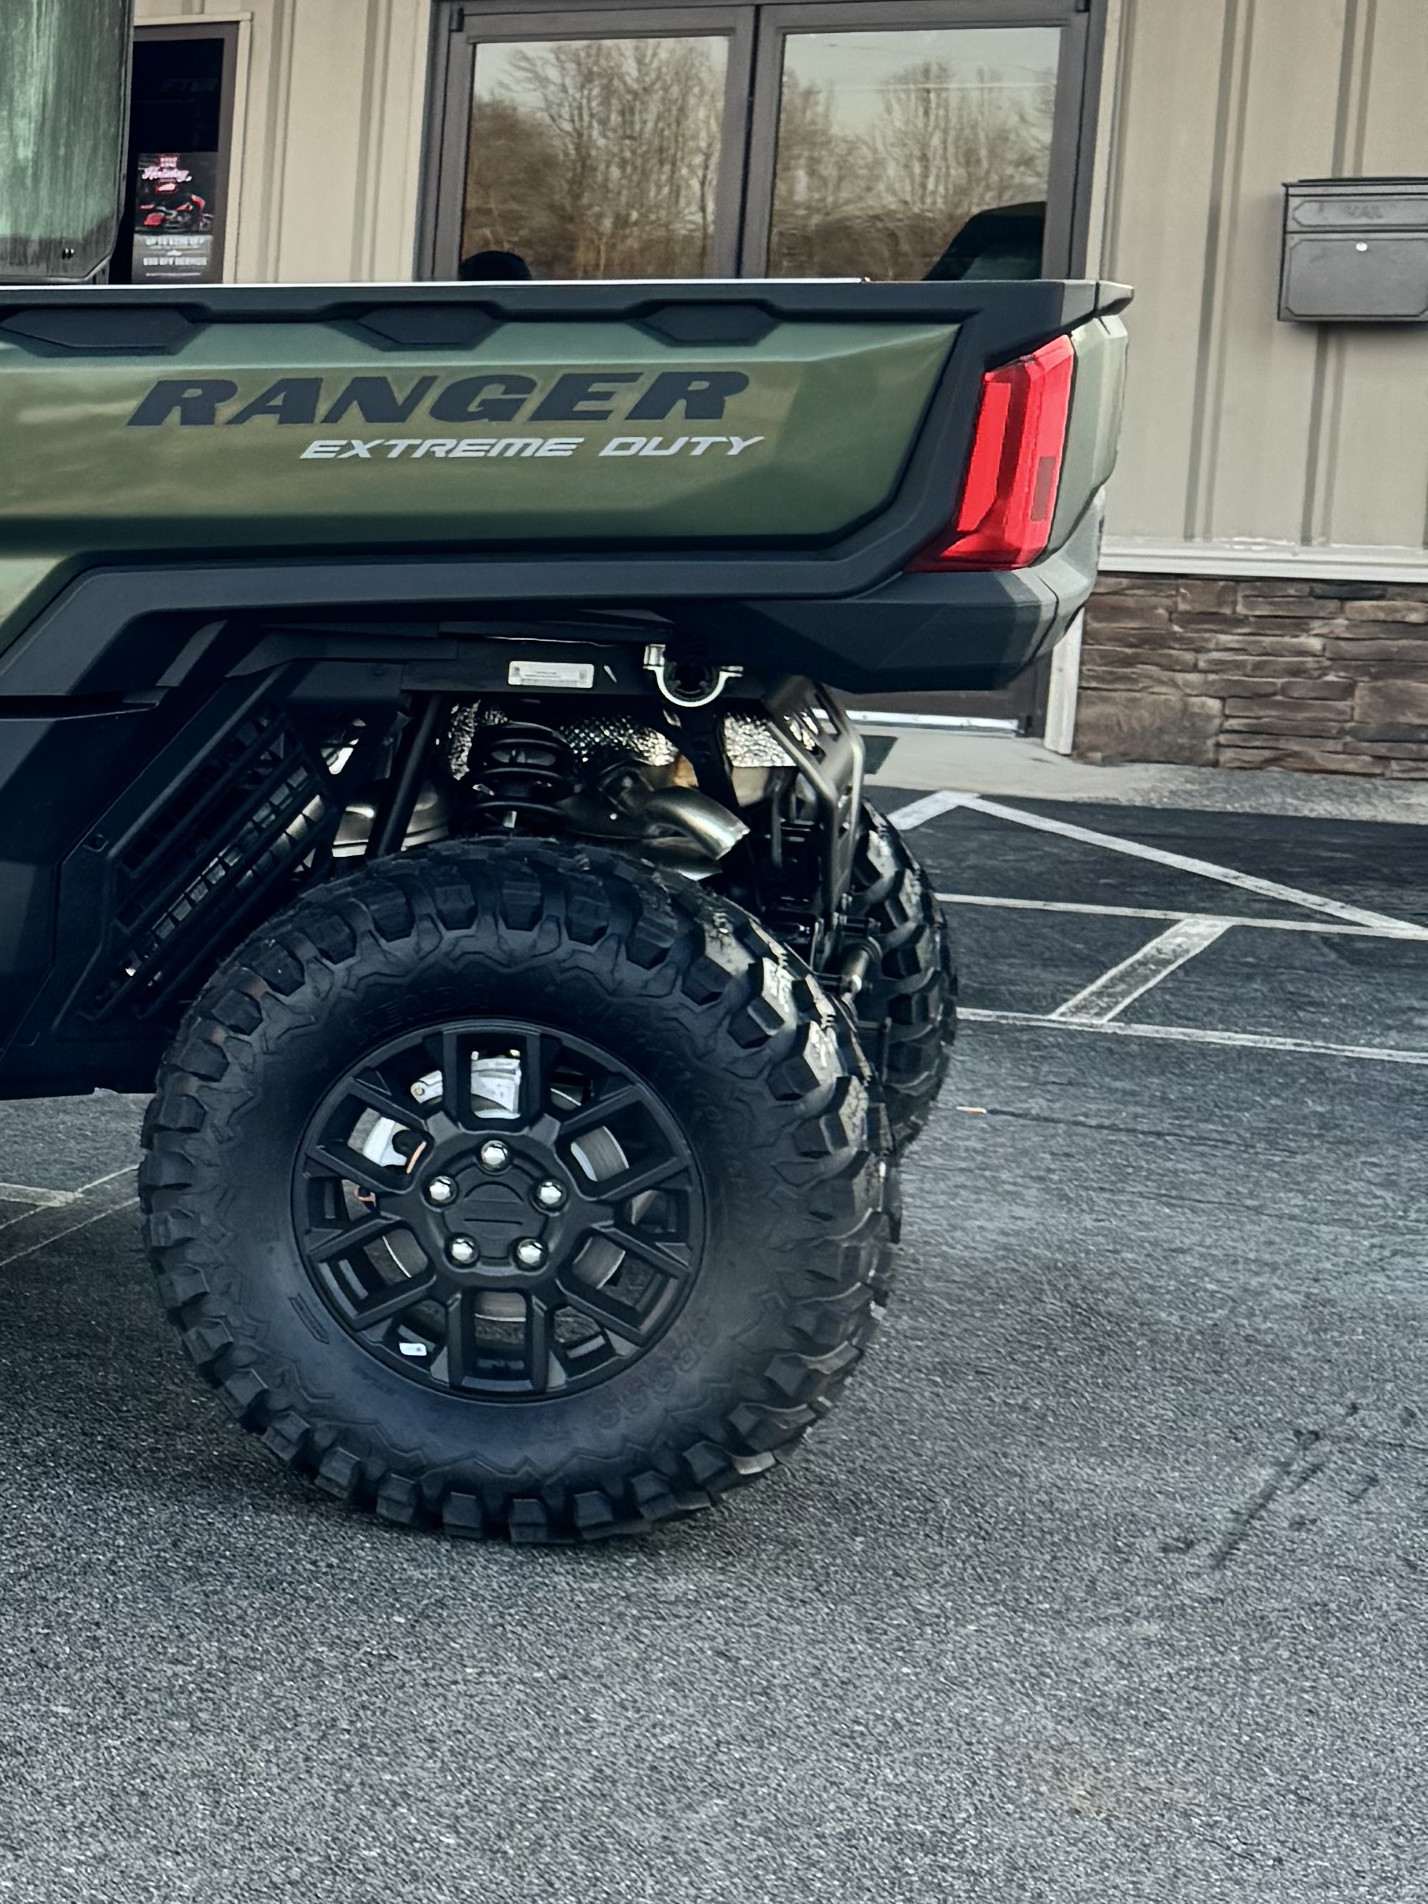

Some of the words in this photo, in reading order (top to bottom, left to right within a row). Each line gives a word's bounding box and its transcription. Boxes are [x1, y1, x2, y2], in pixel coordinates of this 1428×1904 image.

[125, 370, 751, 428] RANGER
[298, 437, 585, 459] EXTREME
[598, 436, 766, 457] DUTY
